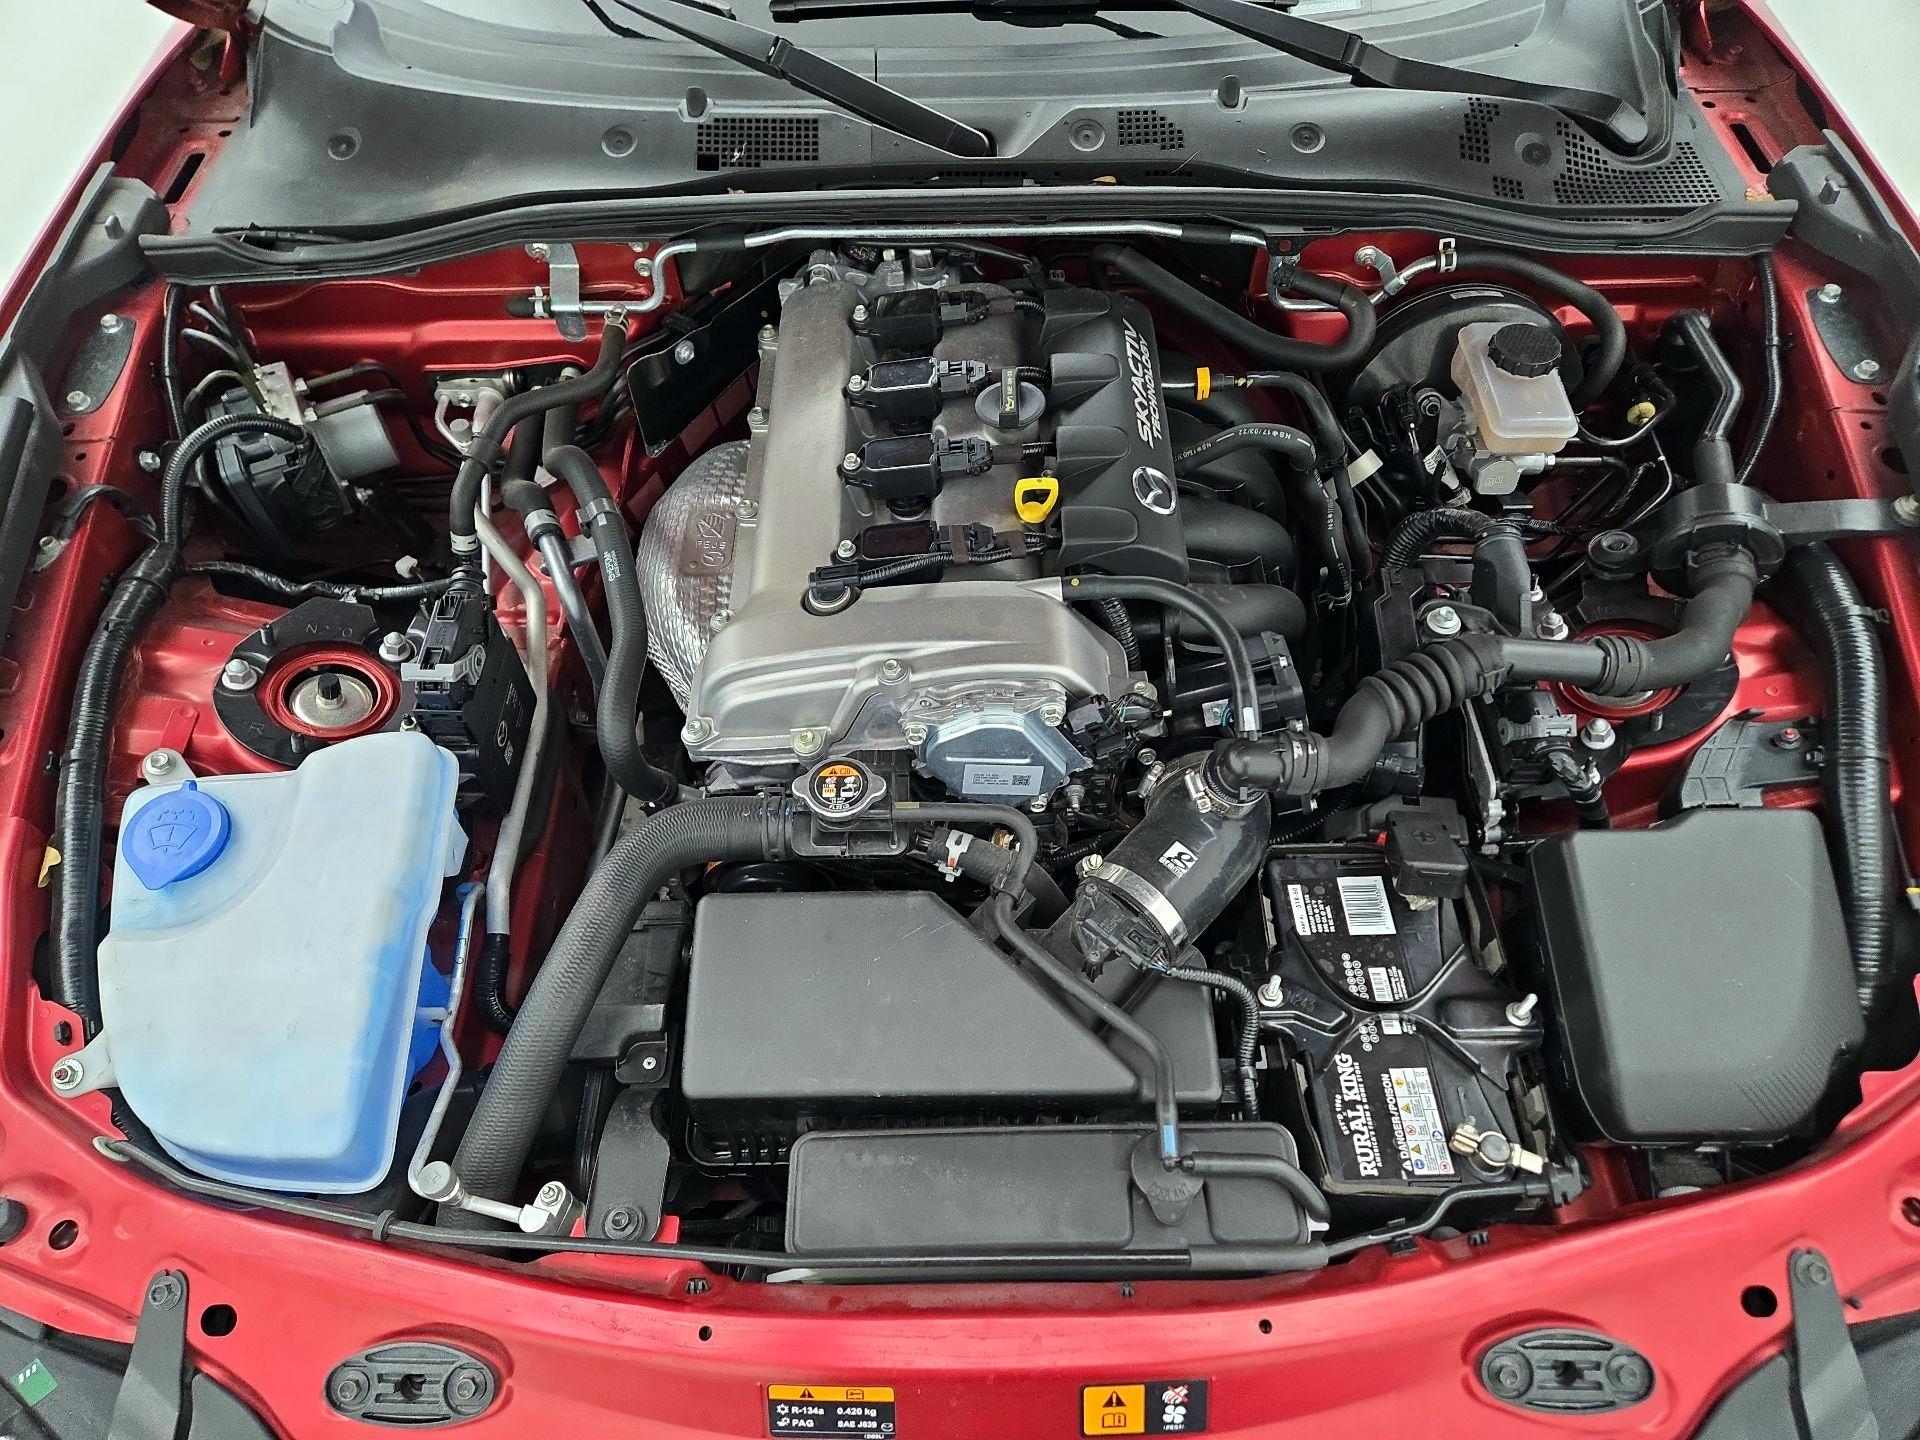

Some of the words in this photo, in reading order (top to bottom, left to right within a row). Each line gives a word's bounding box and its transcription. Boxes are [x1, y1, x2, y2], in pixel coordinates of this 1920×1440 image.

[1122, 317, 1154, 450] SKYACTIV
[1138, 333, 1163, 441] TECHNOLOGY
[1334, 1052, 1362, 1102] KING
[1353, 1061, 1364, 1082] STORE
[1358, 1083, 1368, 1103] HOME
[1346, 1104, 1379, 1177] RURAL
[1380, 1073, 1413, 1160] DANGER/POISON
[791, 1406, 825, 1415] R-134a
[836, 1406, 863, 1416] 0.420
[864, 1406, 877, 1417] kg
[791, 1418, 815, 1428] PAG
[837, 1420, 856, 1428] SAE
